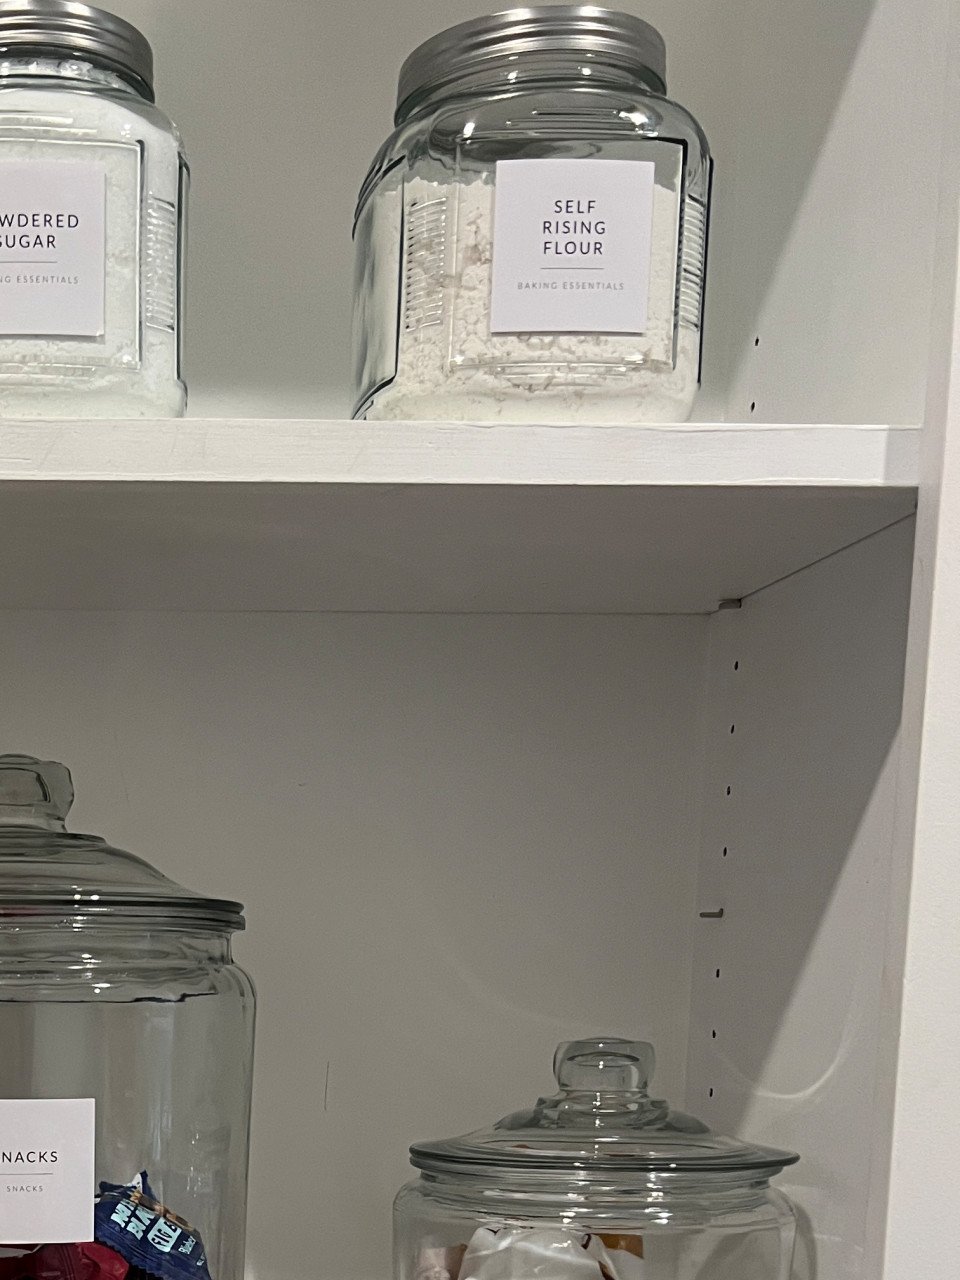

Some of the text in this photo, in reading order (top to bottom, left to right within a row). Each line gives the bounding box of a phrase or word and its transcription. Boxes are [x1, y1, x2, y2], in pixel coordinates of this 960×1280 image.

[553, 199, 597, 214] SELF
[542, 220, 606, 235] RISING
[543, 240, 603, 256] FLOUR
[16, 275, 79, 285] ESSENTIALS
[517, 281, 624, 291] BAKING ESSENTIALS
[6, 1185, 44, 1193] SNACKS
